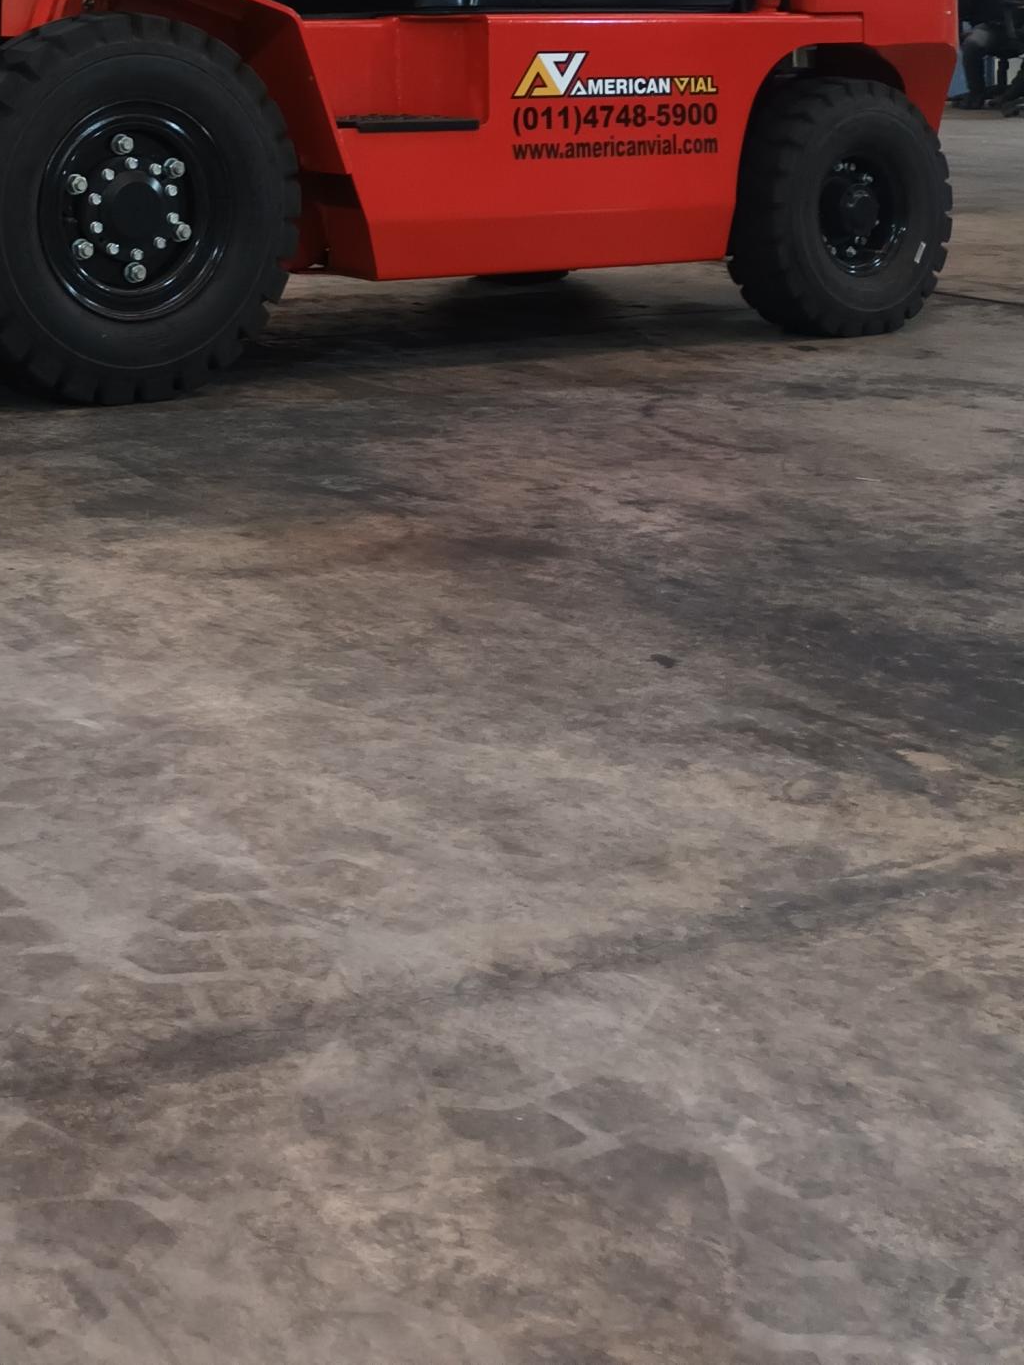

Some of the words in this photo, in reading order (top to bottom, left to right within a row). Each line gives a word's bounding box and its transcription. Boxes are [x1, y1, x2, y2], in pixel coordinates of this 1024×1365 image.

[571, 77, 671, 96] AMERICAN
[673, 76, 718, 93] VIAL
[513, 102, 718, 135] (011)4748-5900
[512, 135, 718, 160] www.americanvial.com
